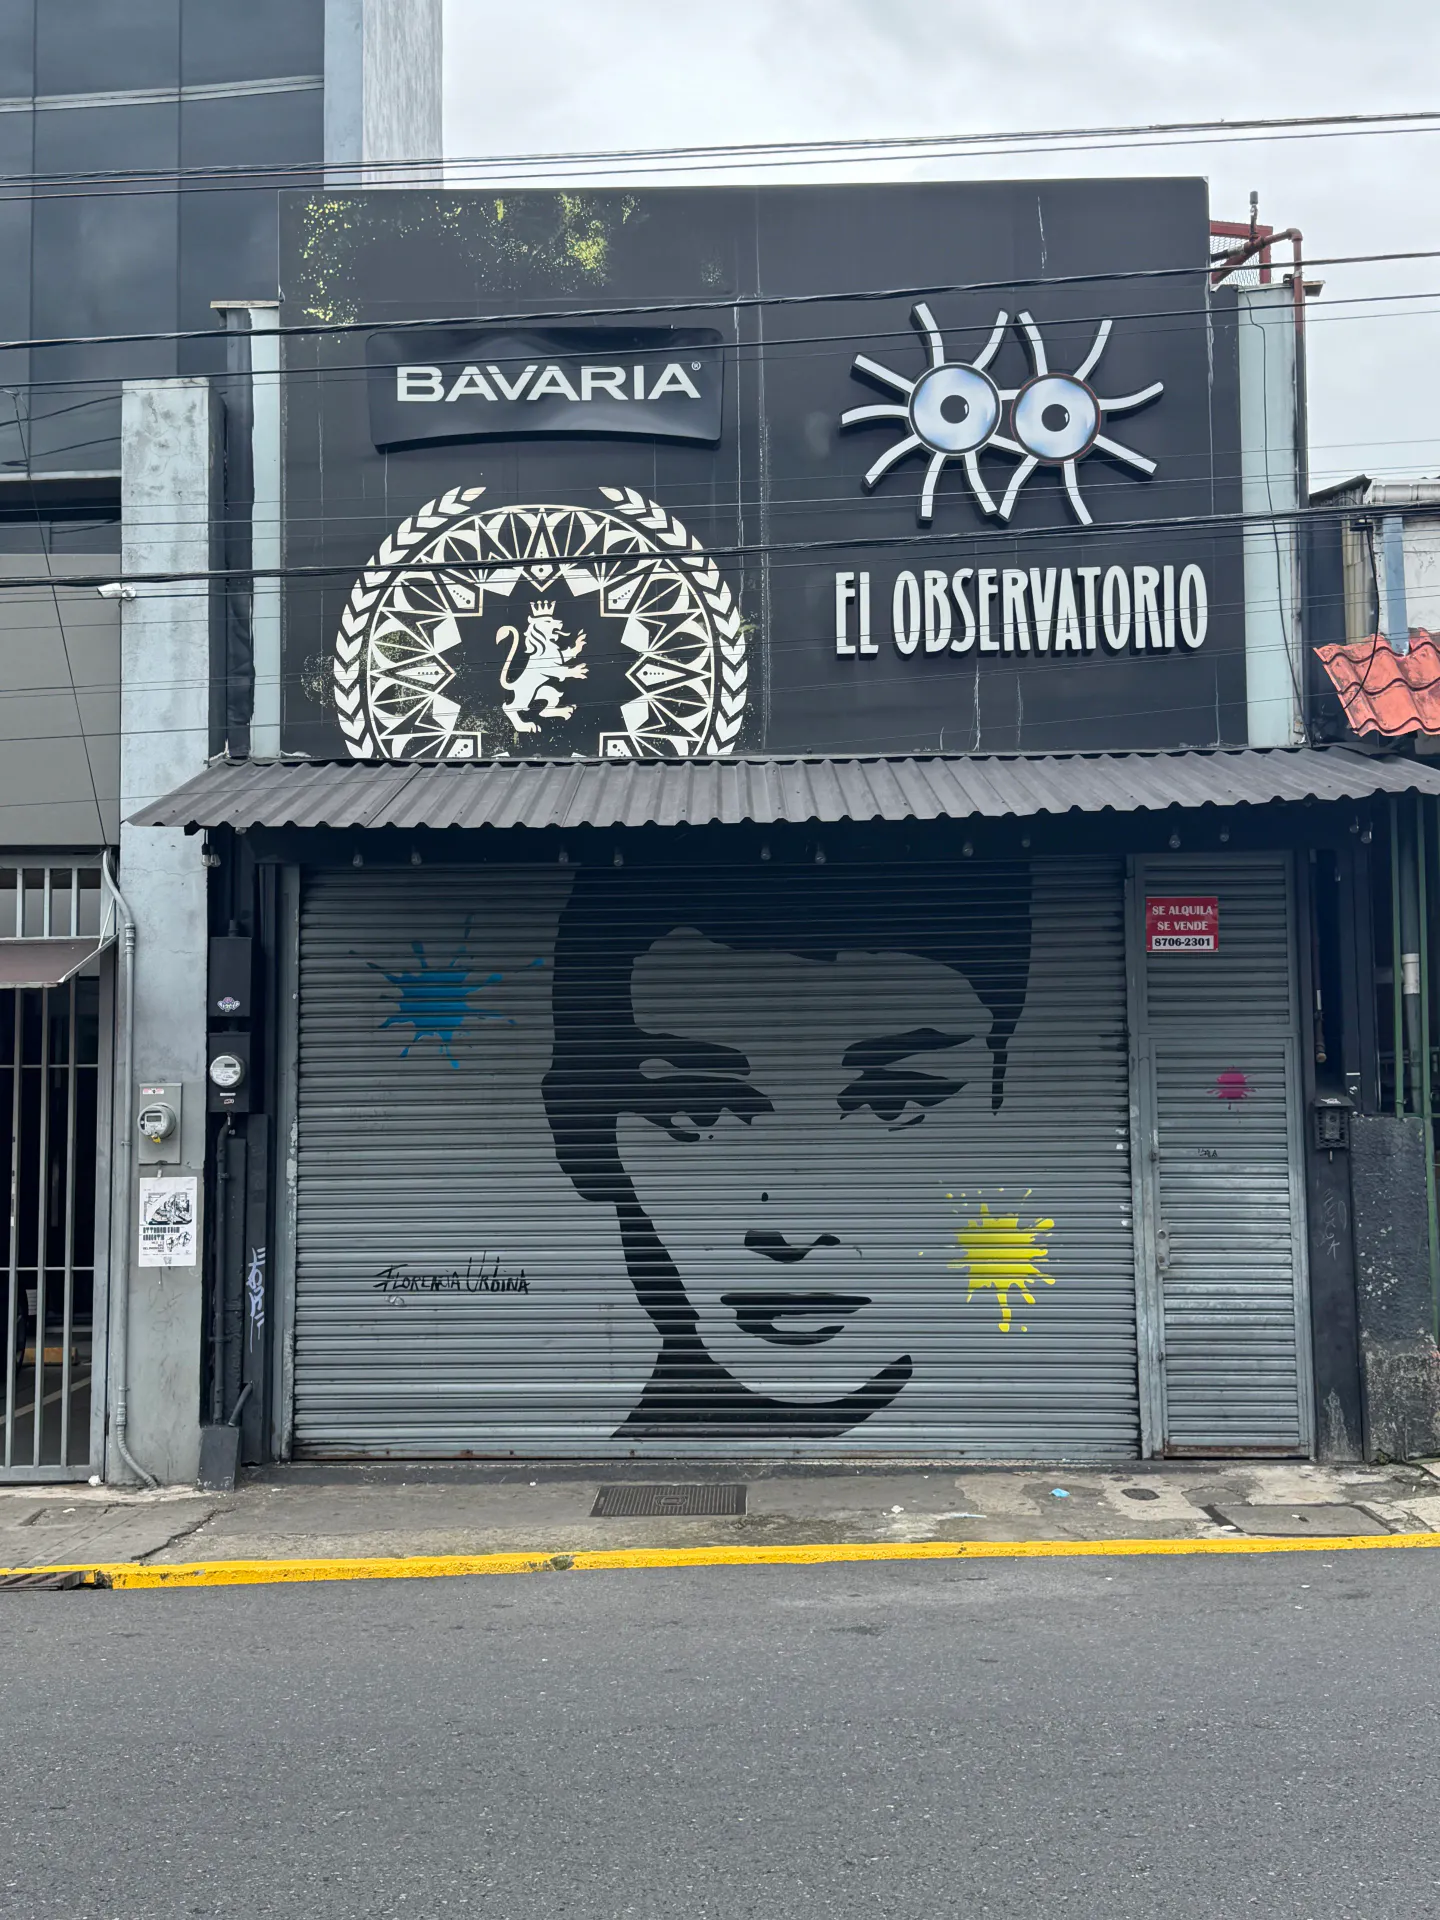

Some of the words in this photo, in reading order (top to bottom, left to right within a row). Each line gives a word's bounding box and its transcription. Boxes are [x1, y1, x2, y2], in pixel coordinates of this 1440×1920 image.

[835, 571, 879, 656] EL
[892, 563, 1209, 656] OBSERVATORIO
[1152, 906, 1166, 915] SE
[1168, 906, 1213, 916] ALQUILA
[1157, 921, 1171, 930] SE
[1173, 921, 1208, 930] VENDE
[1154, 938, 1210, 946] 8706-2301
